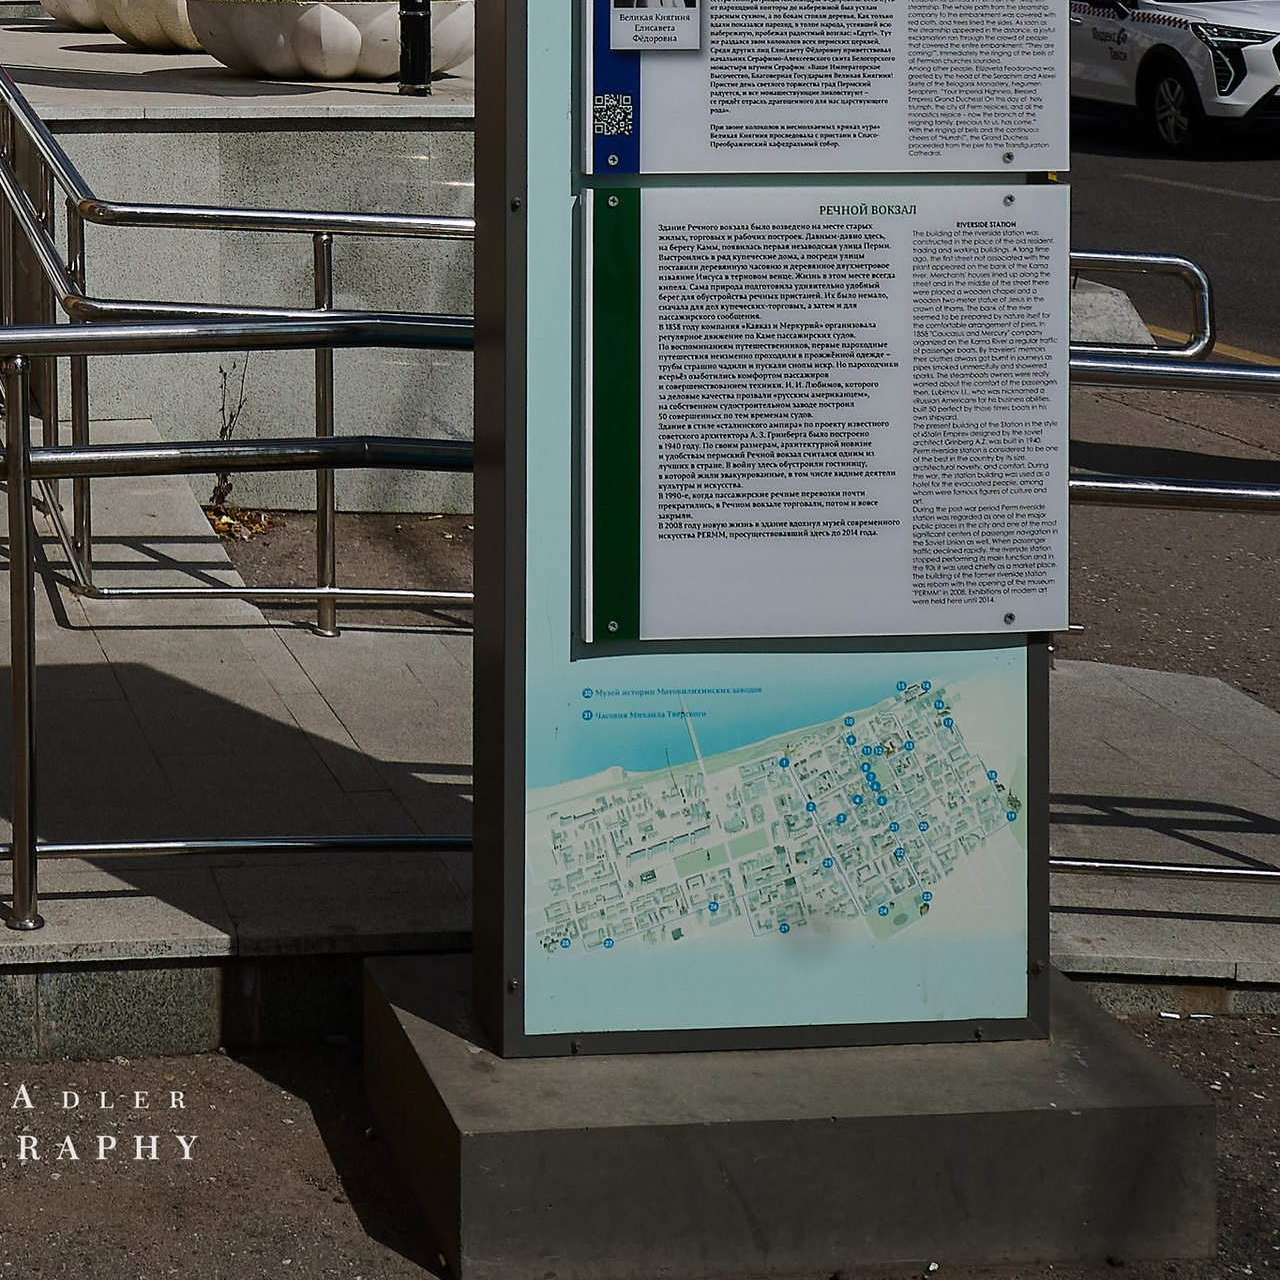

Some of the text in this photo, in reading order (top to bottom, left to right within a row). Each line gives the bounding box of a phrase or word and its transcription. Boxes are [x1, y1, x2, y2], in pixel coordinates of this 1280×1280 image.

[635, 24, 675, 32] Елисавета
[819, 203, 916, 215] РЕЧНОЙ ВОКЗАЛ
